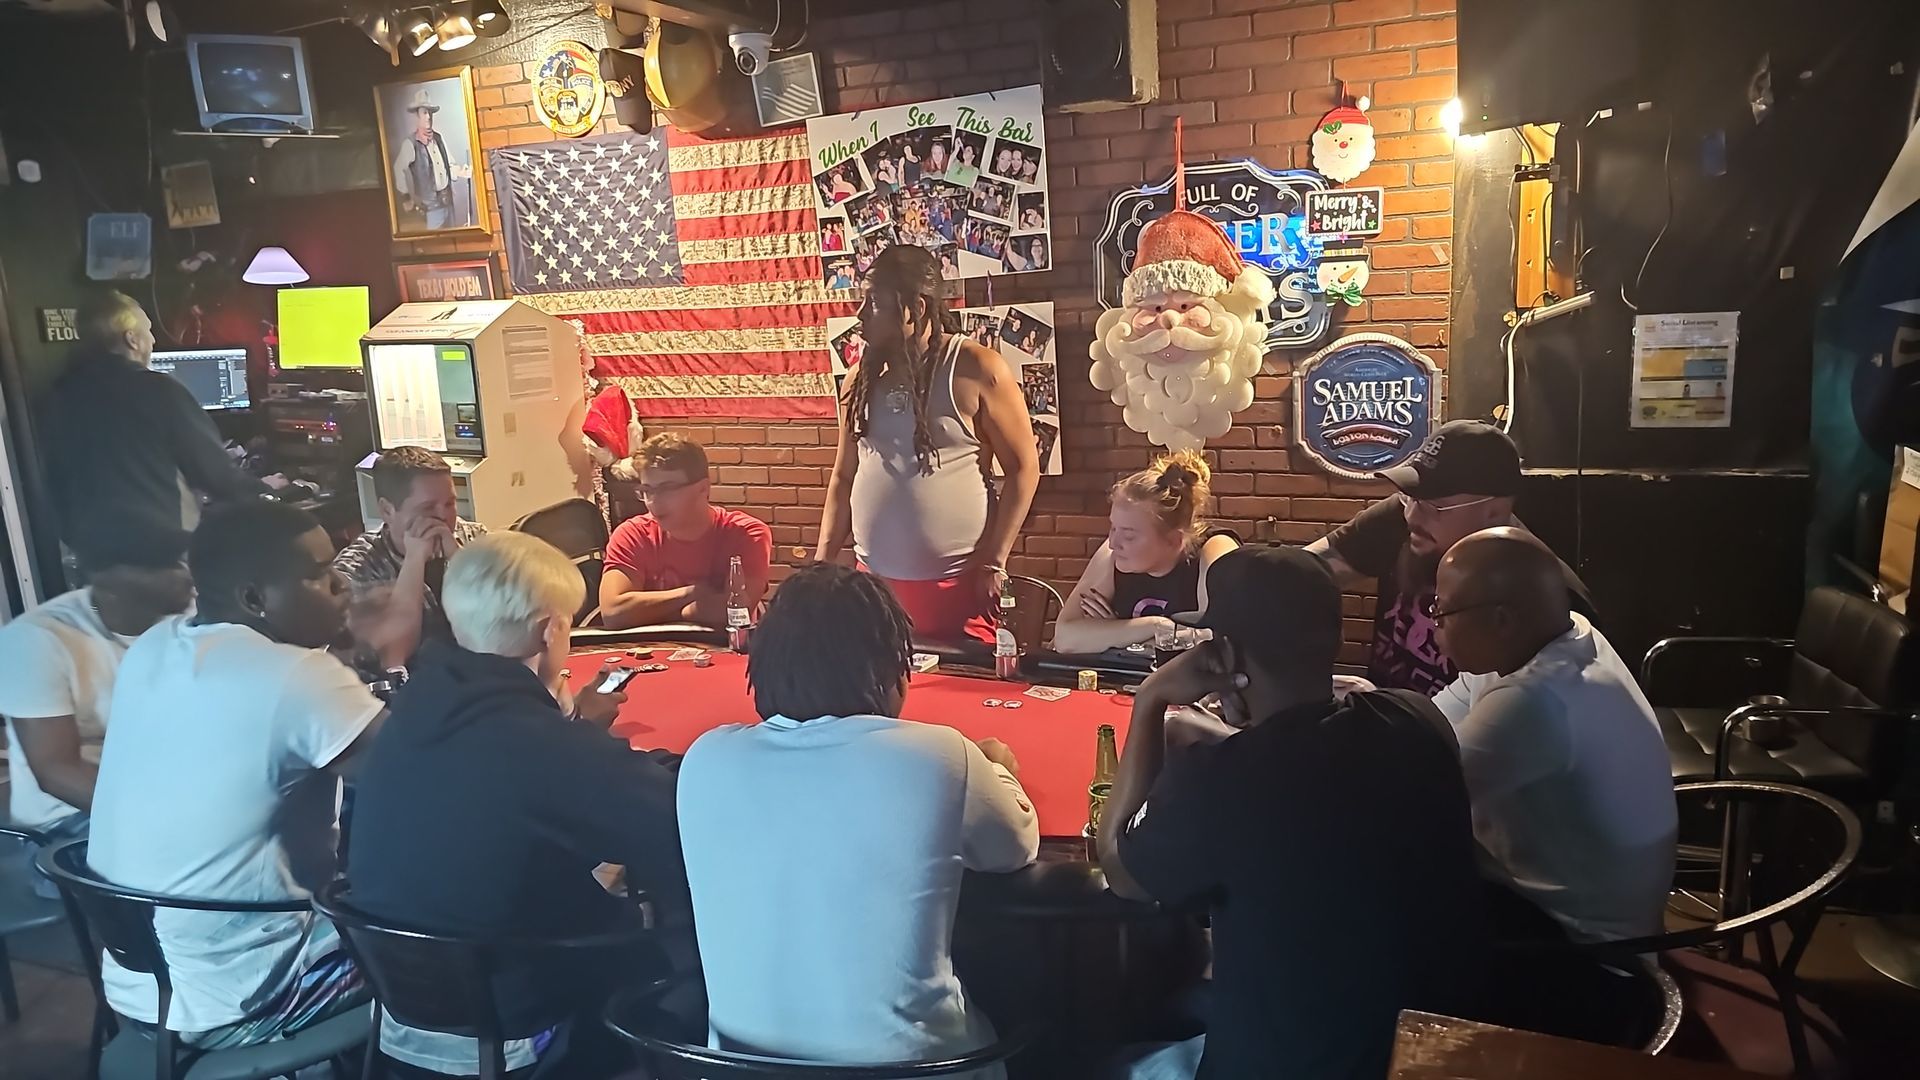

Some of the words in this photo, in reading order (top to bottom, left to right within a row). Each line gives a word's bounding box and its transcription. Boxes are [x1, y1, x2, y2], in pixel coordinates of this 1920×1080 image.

[818, 136, 868, 169] When
[869, 120, 880, 142] I
[907, 106, 937, 127] See
[956, 106, 994, 134] This
[997, 117, 1035, 143] Bar
[1231, 183, 1259, 203] OF
[1314, 194, 1359, 214] Merry
[1362, 194, 1375, 208] &
[1322, 210, 1367, 232] Bright
[1218, 212, 1300, 256] ER
[416, 279, 442, 299] TEXAS
[1313, 376, 1423, 405] SAMUEL
[1318, 401, 1413, 427] ADAMS
